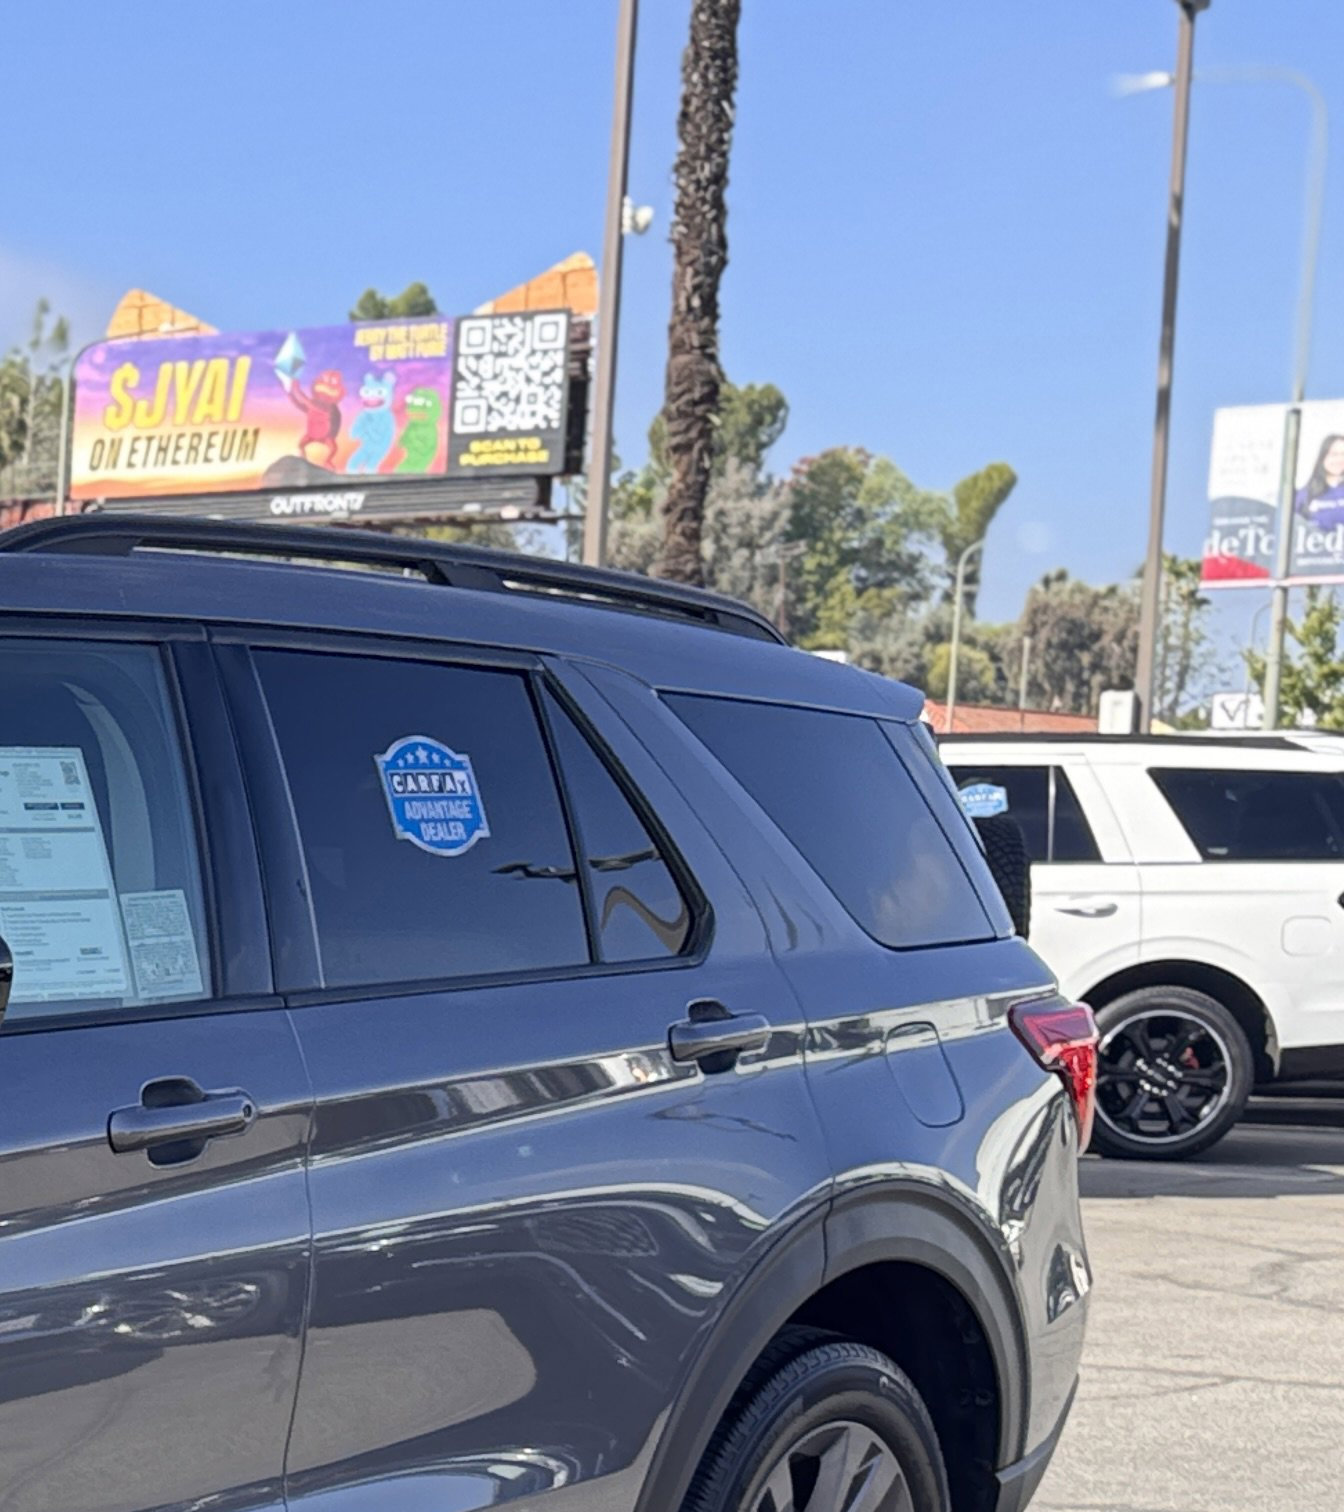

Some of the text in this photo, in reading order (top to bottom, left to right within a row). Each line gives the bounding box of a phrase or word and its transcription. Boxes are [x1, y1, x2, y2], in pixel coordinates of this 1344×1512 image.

[103, 355, 252, 431] $JYAI
[89, 427, 261, 471] ON ETHEREUM
[392, 773, 471, 794] CARFAX
[404, 800, 472, 820] ADVANTAGE
[419, 821, 467, 841] DEALER
